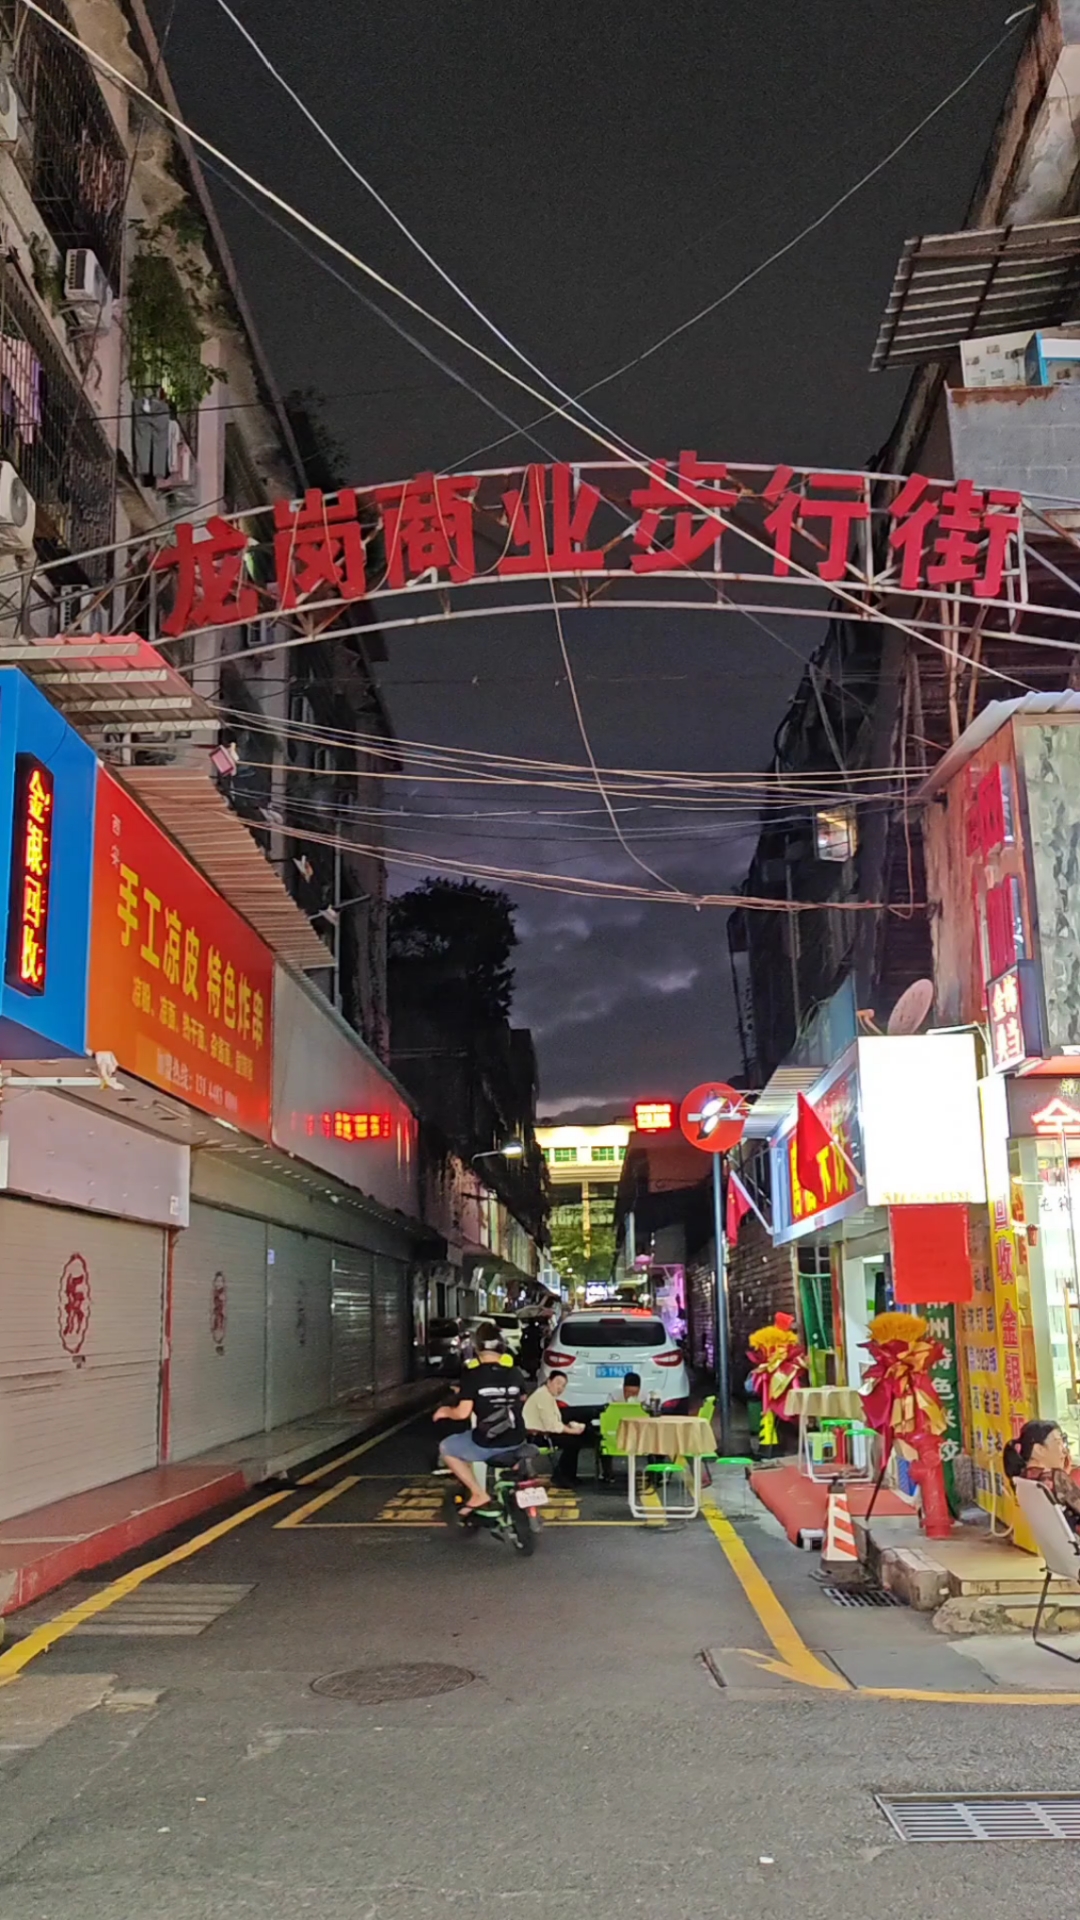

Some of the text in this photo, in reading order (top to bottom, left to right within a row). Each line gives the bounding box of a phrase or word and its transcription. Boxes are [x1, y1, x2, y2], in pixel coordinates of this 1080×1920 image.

[151, 449, 1022, 637] 龙岗商业步行街
[20, 769, 47, 983] 金银回收
[117, 864, 263, 1050] 手工凉皮 特色炸串
